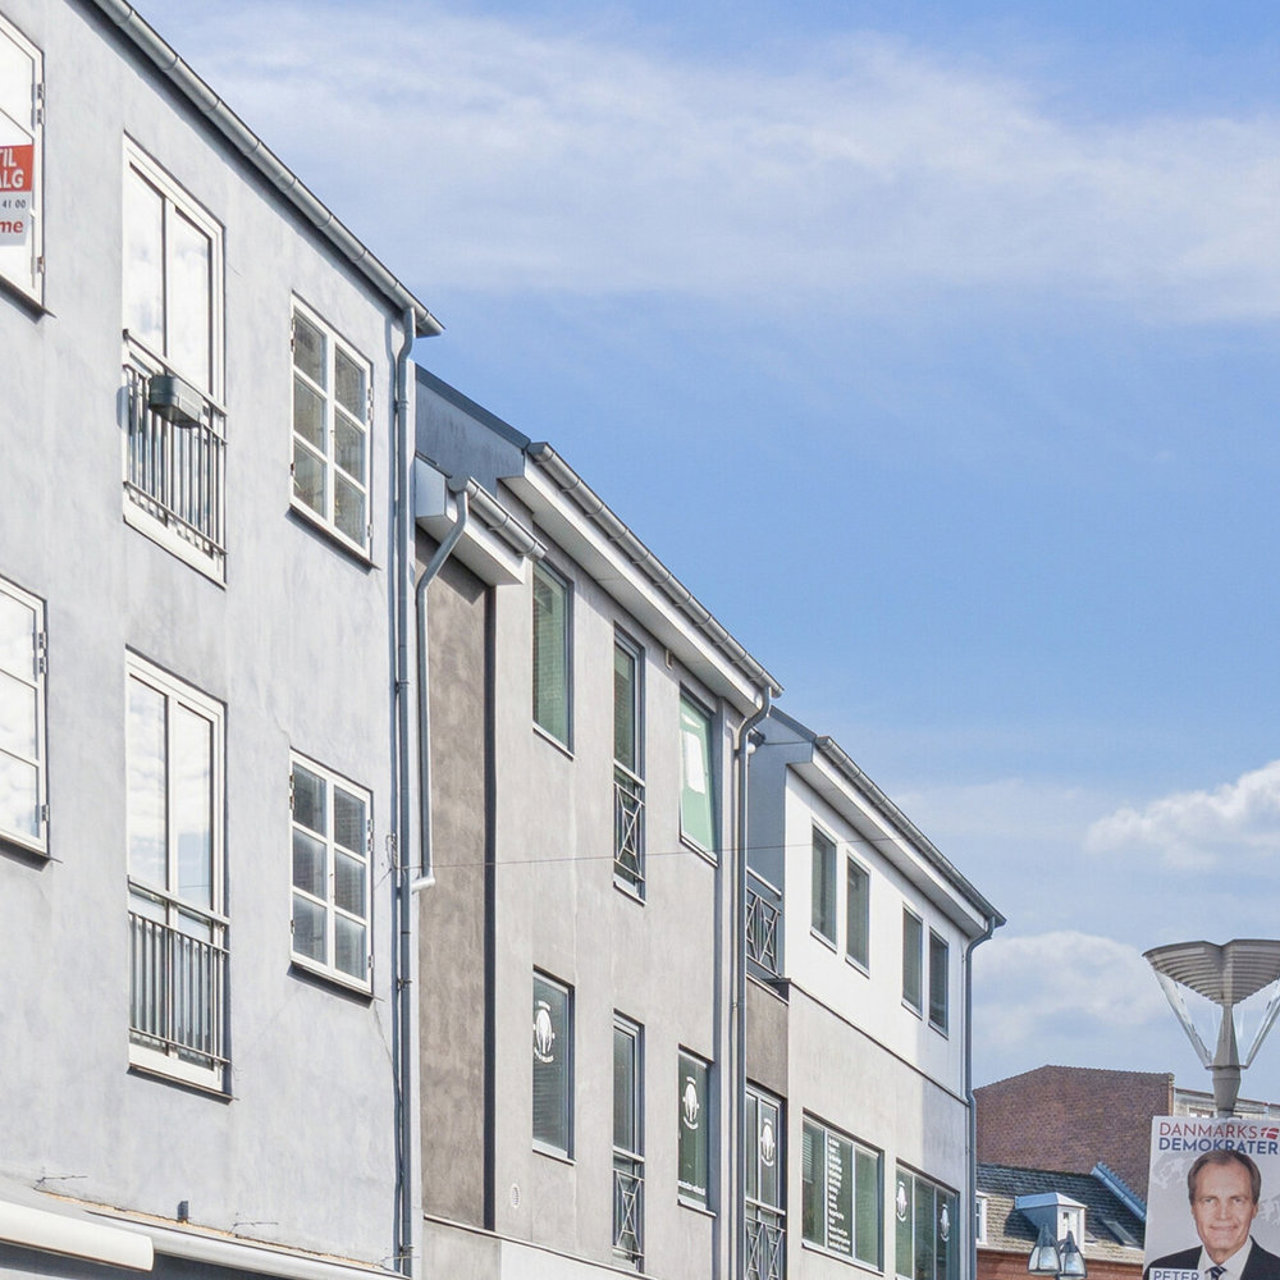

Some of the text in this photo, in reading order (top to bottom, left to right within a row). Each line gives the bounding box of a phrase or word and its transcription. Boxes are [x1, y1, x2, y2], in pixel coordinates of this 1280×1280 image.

[2, 199, 12, 208] 41
[15, 199, 27, 208] 00
[1159, 1122, 1258, 1139] DANMARKS
